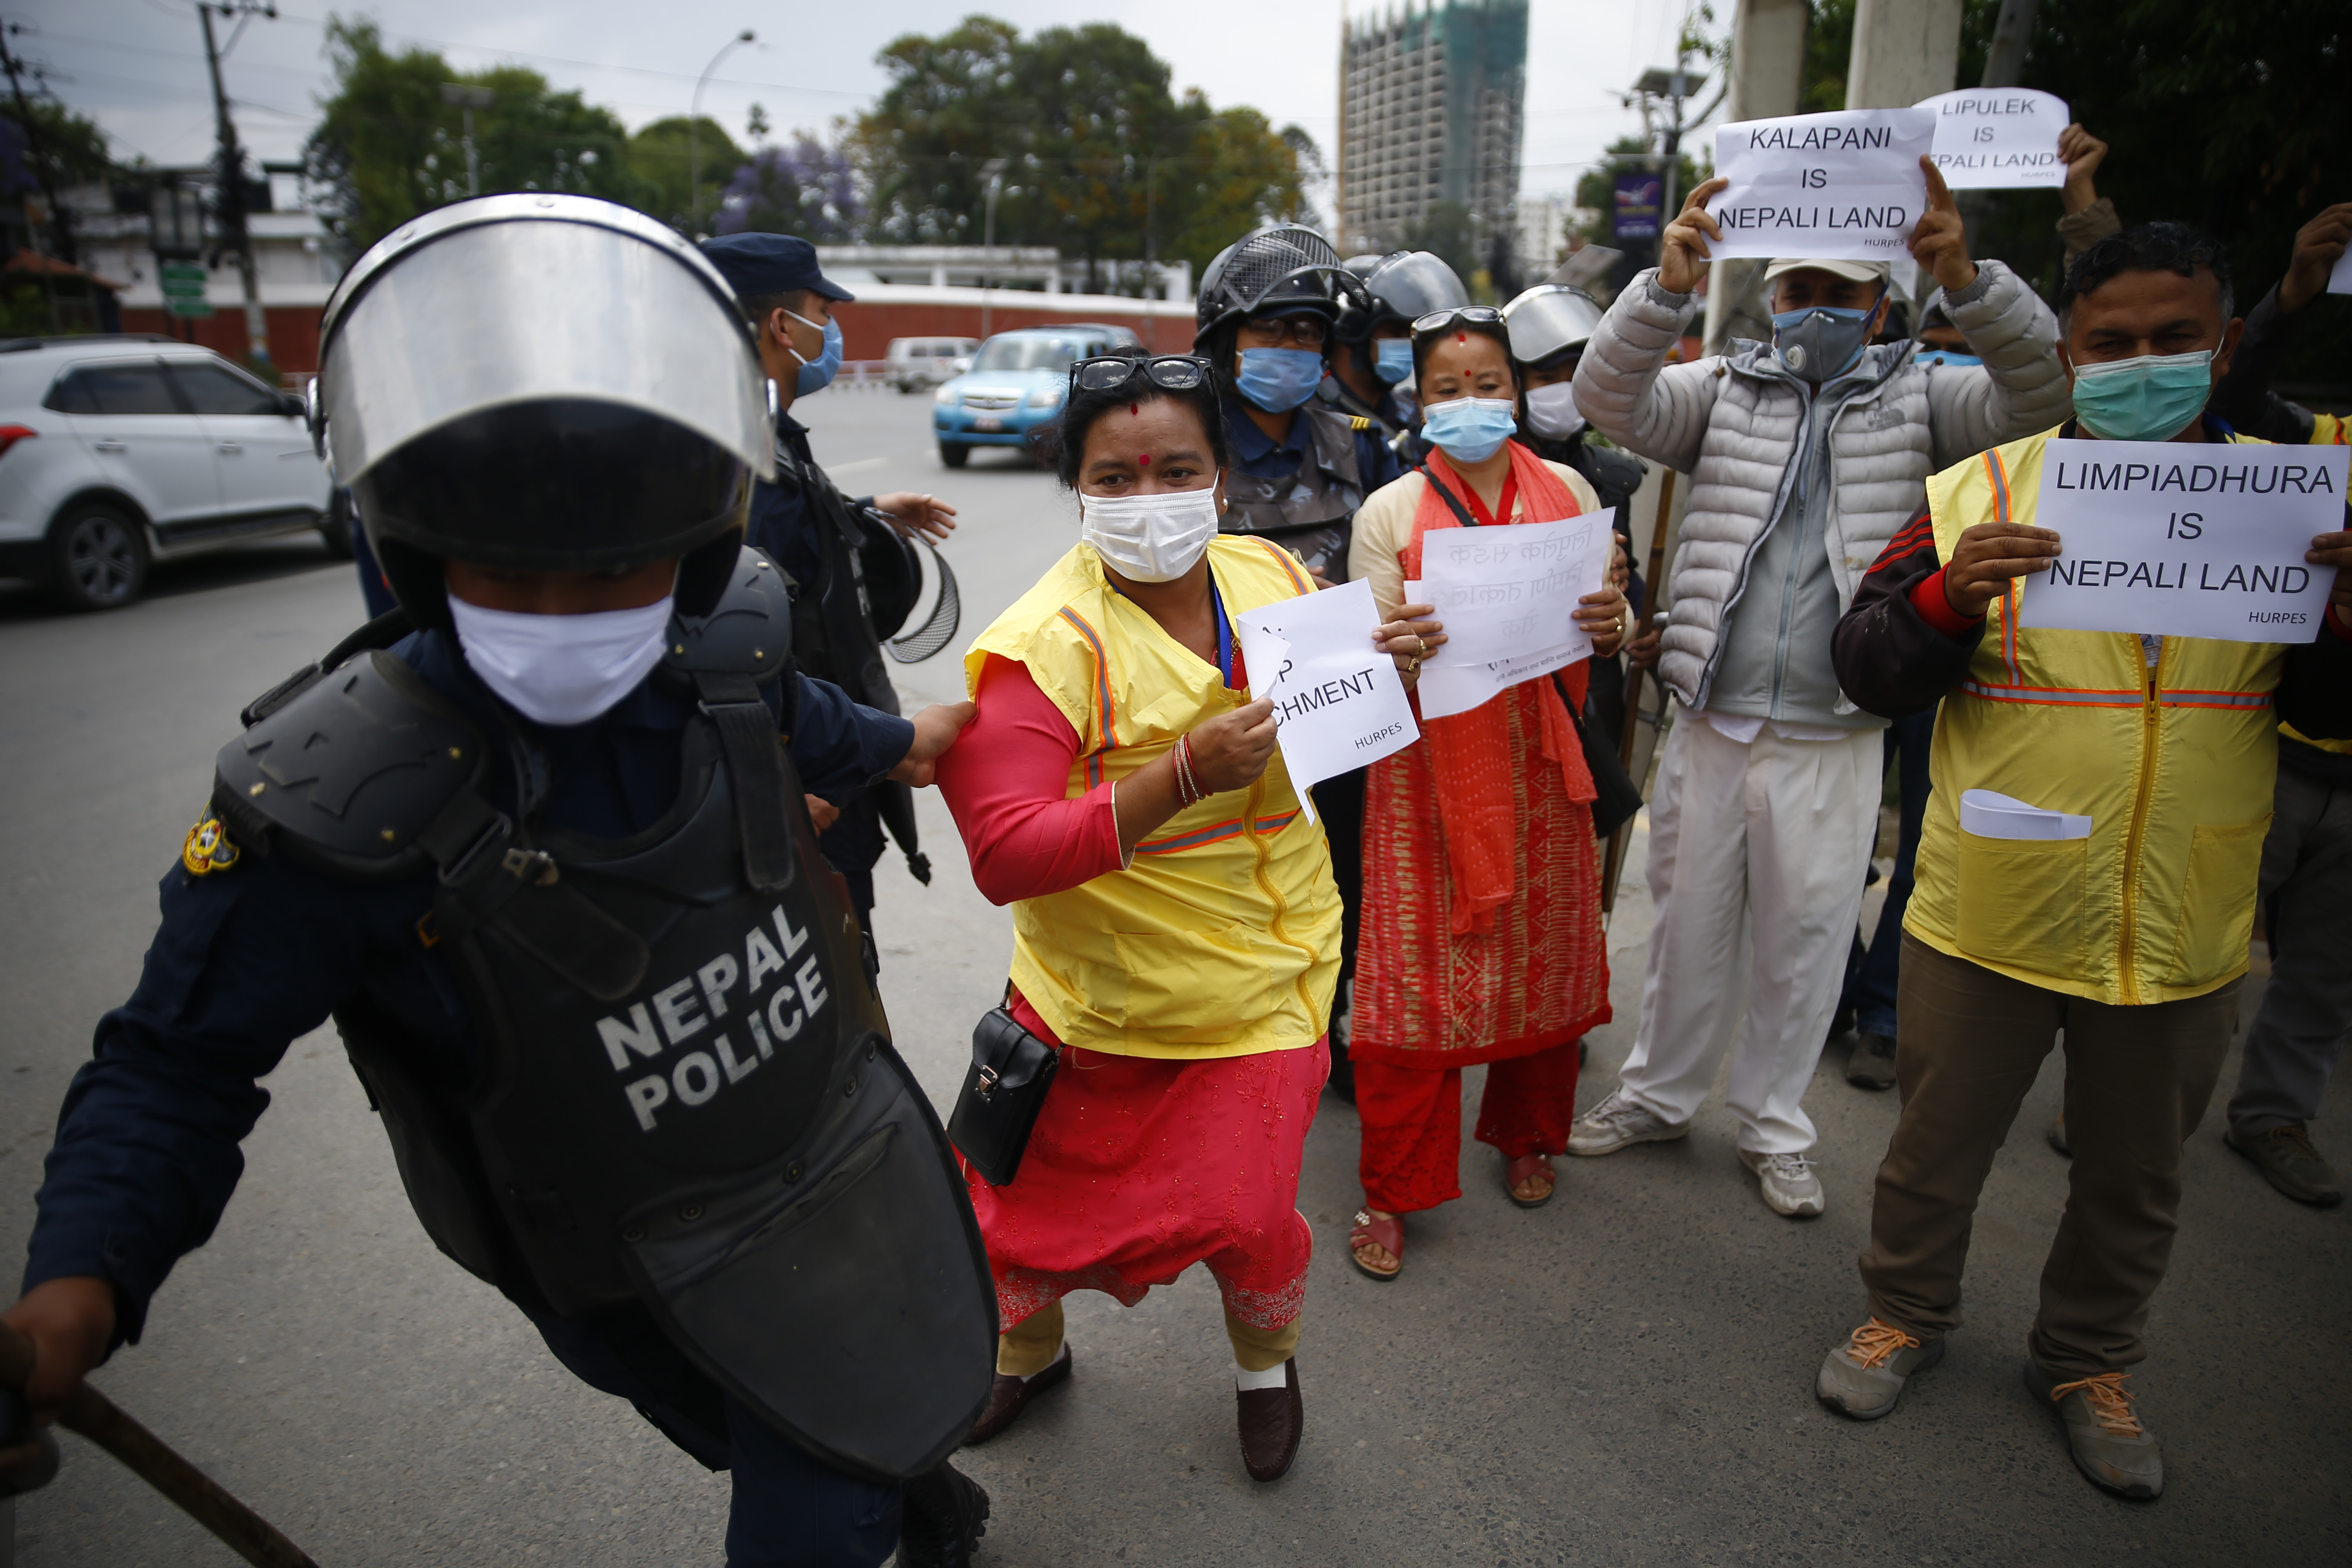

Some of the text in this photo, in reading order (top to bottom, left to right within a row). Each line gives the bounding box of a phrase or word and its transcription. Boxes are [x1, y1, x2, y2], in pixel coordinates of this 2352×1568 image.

[1942, 98, 2035, 114] LIPULEK
[1750, 127, 1891, 149] KALAPANI
[1974, 127, 1994, 142] IS
[1993, 152, 2054, 167] LAND
[1802, 168, 1827, 188] IS
[1719, 206, 1906, 228] NEPALI LAND
[1865, 238, 1906, 248] HURPES
[2056, 462, 2333, 493] LIMPIADHURA
[2167, 512, 2203, 539] IS
[2049, 559, 2309, 594] NEPALI LAND
[2249, 612, 2307, 624] HURPES
[1354, 722, 1402, 749] HURPES
[596, 903, 809, 1072] NEPAL
[624, 953, 828, 1132] POLICE
